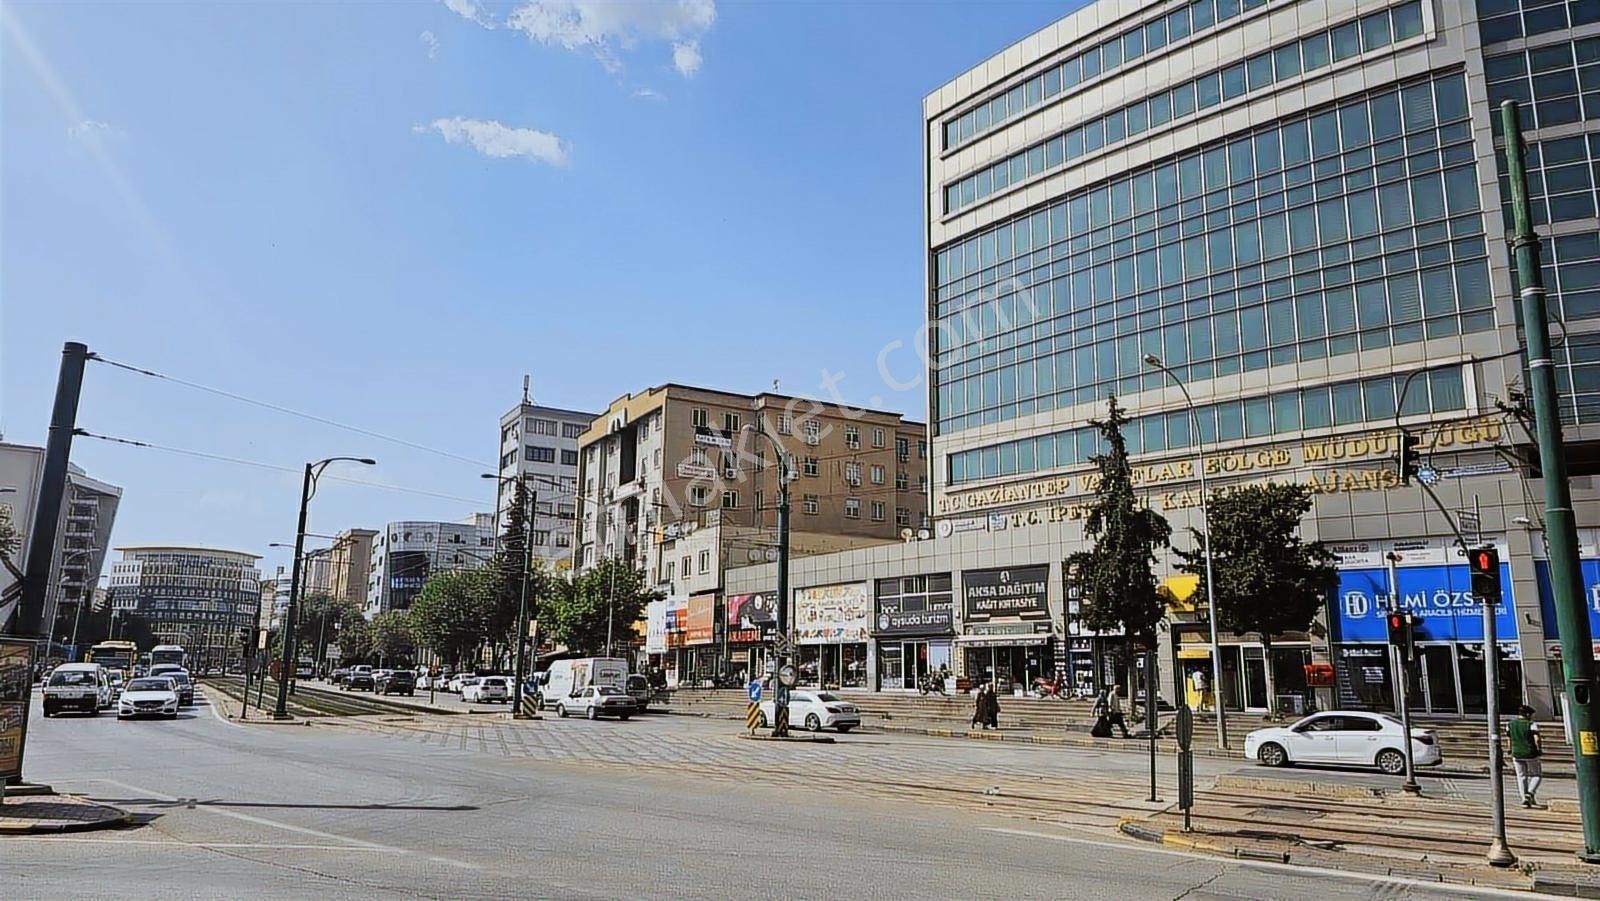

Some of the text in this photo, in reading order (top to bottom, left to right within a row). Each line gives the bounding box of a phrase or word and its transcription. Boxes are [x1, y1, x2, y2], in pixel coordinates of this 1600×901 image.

[966, 477, 1070, 508] GAZİANTEP
[1302, 463, 1407, 495] AJANS
[968, 581, 1046, 598] AKSA DAĞITIM
